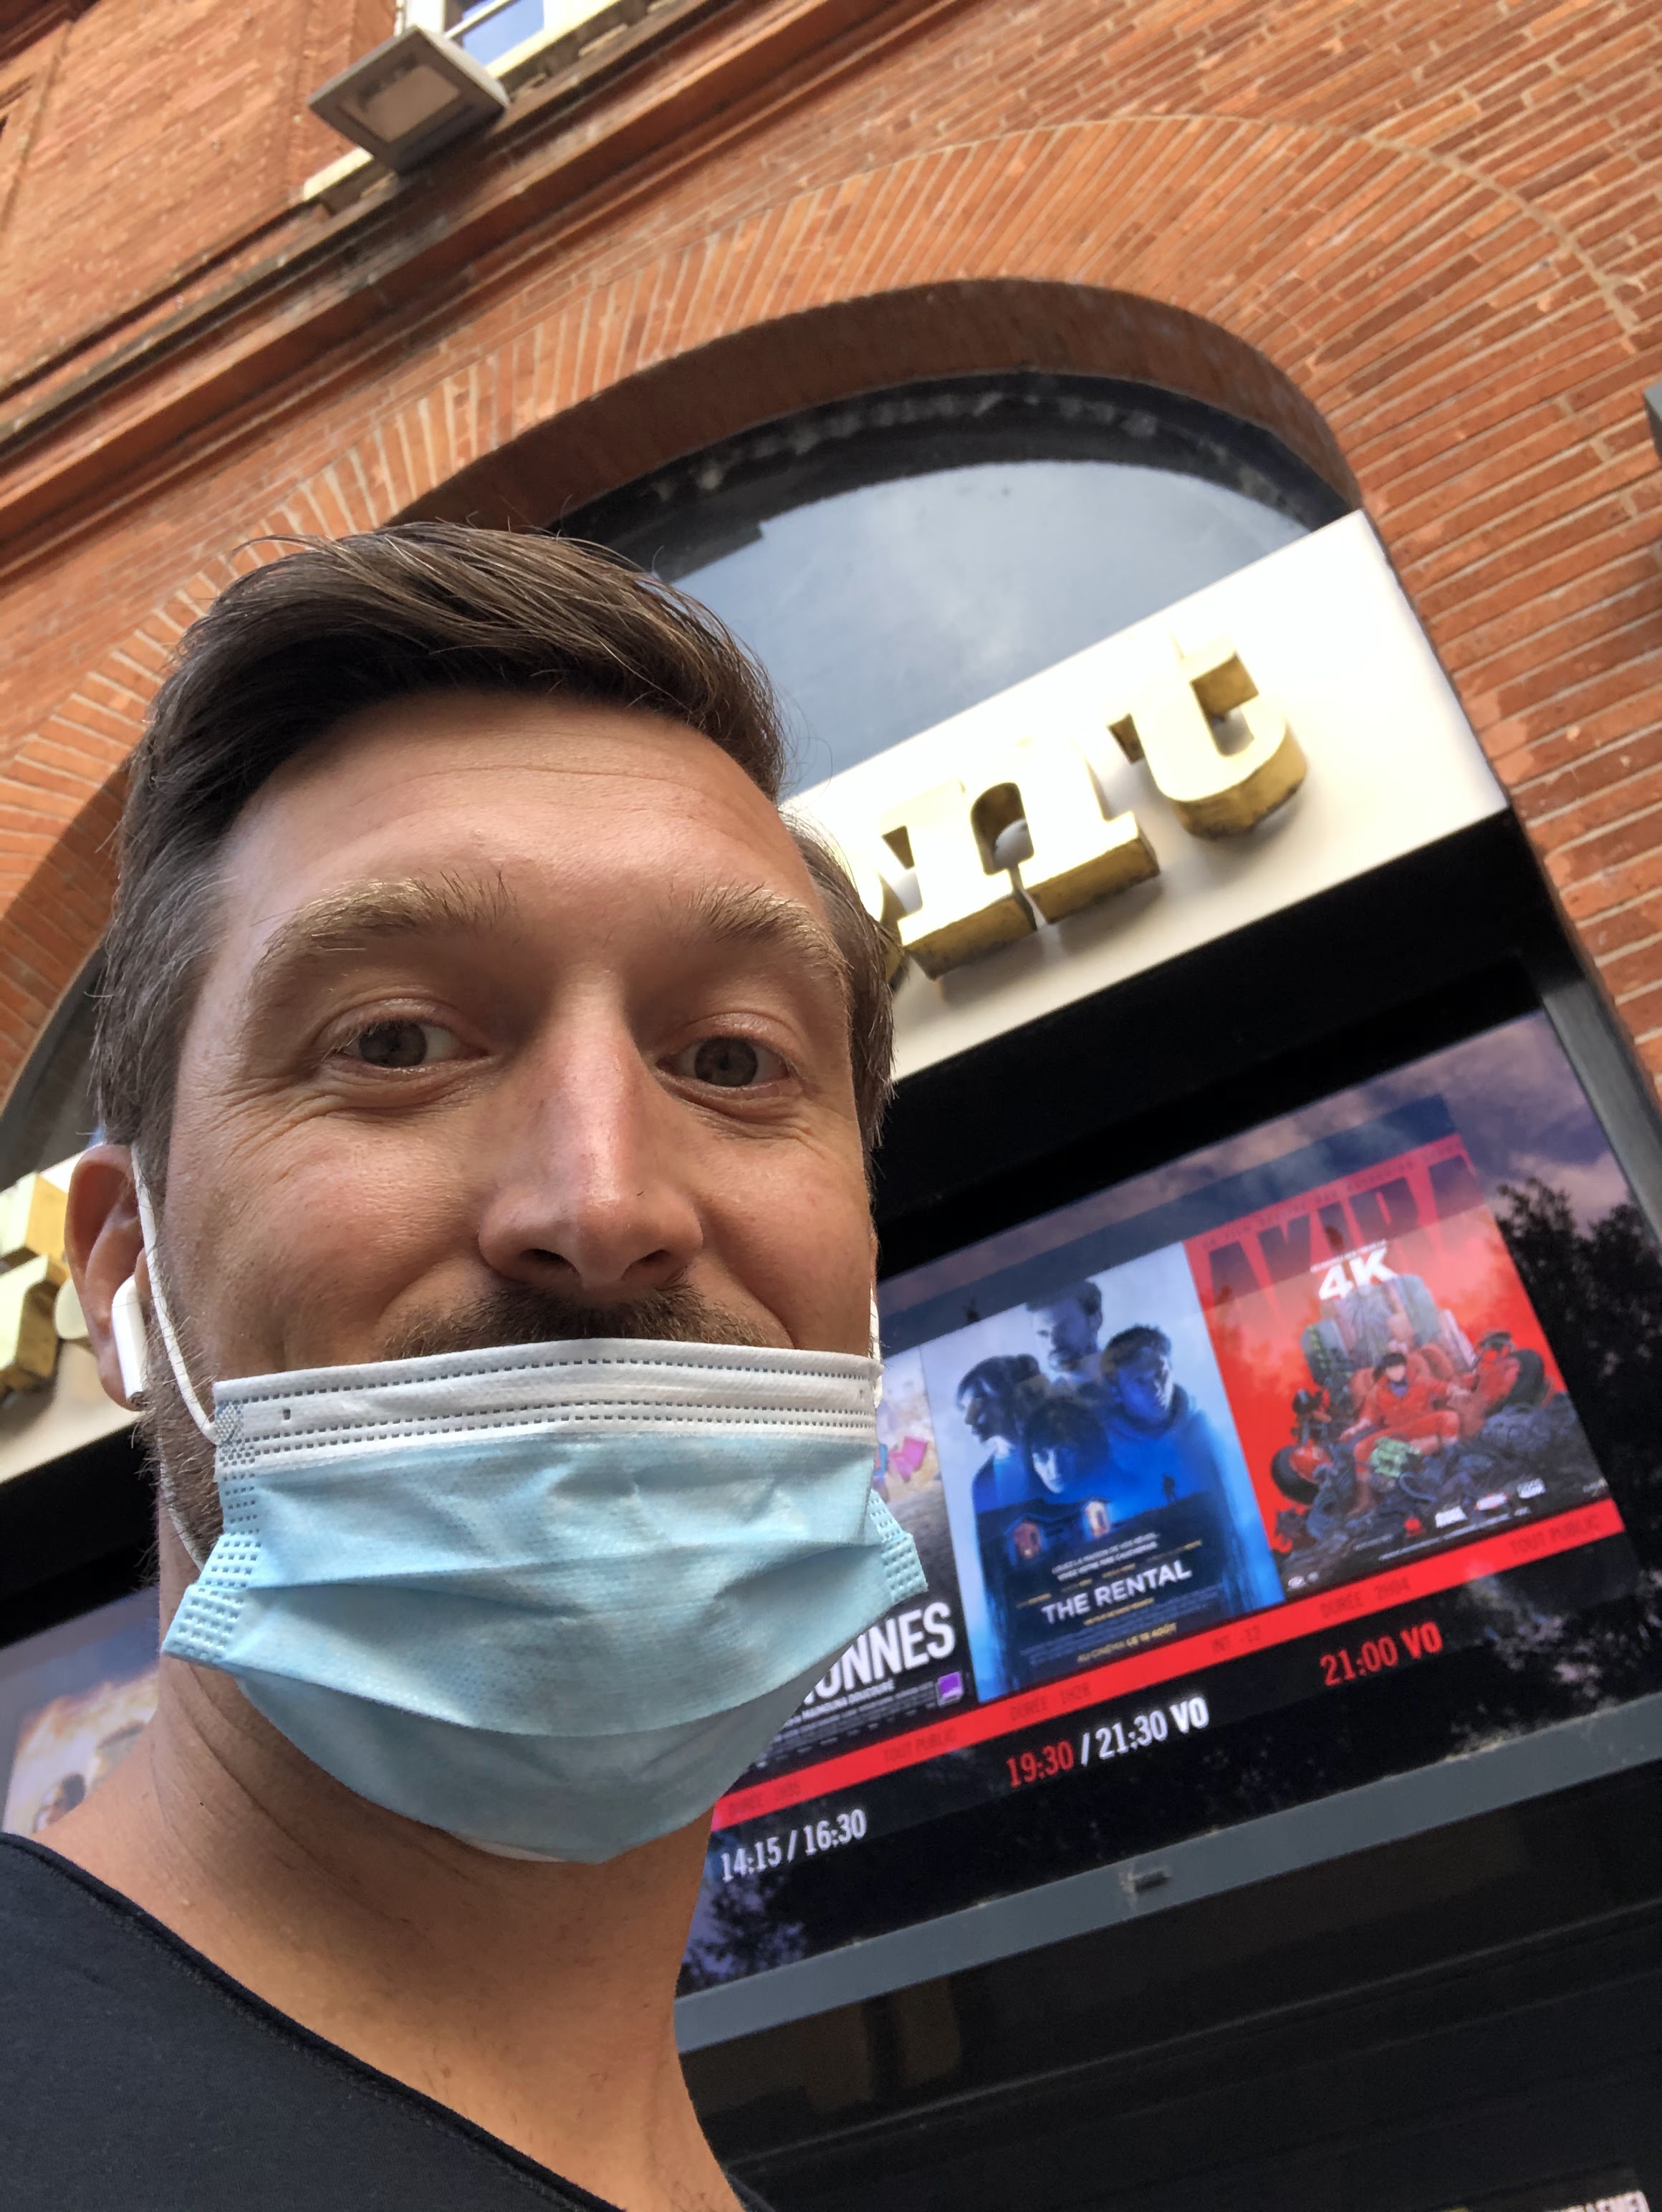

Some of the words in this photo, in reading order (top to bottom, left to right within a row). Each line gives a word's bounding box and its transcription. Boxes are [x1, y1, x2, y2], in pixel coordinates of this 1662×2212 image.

[1318, 1246, 1398, 1302] 4K
[1041, 1592, 1091, 1625] THE
[1093, 1559, 1193, 1607] RENTAL
[1320, 1635, 1398, 1686] 21:00
[1400, 1621, 1444, 1660] VO
[1007, 1740, 1075, 1789] 19:30
[1095, 1709, 1168, 1760] 21:30
[1170, 1696, 1210, 1734] VO
[721, 1836, 782, 1882] 14:15
[803, 1808, 868, 1856] 16:30
